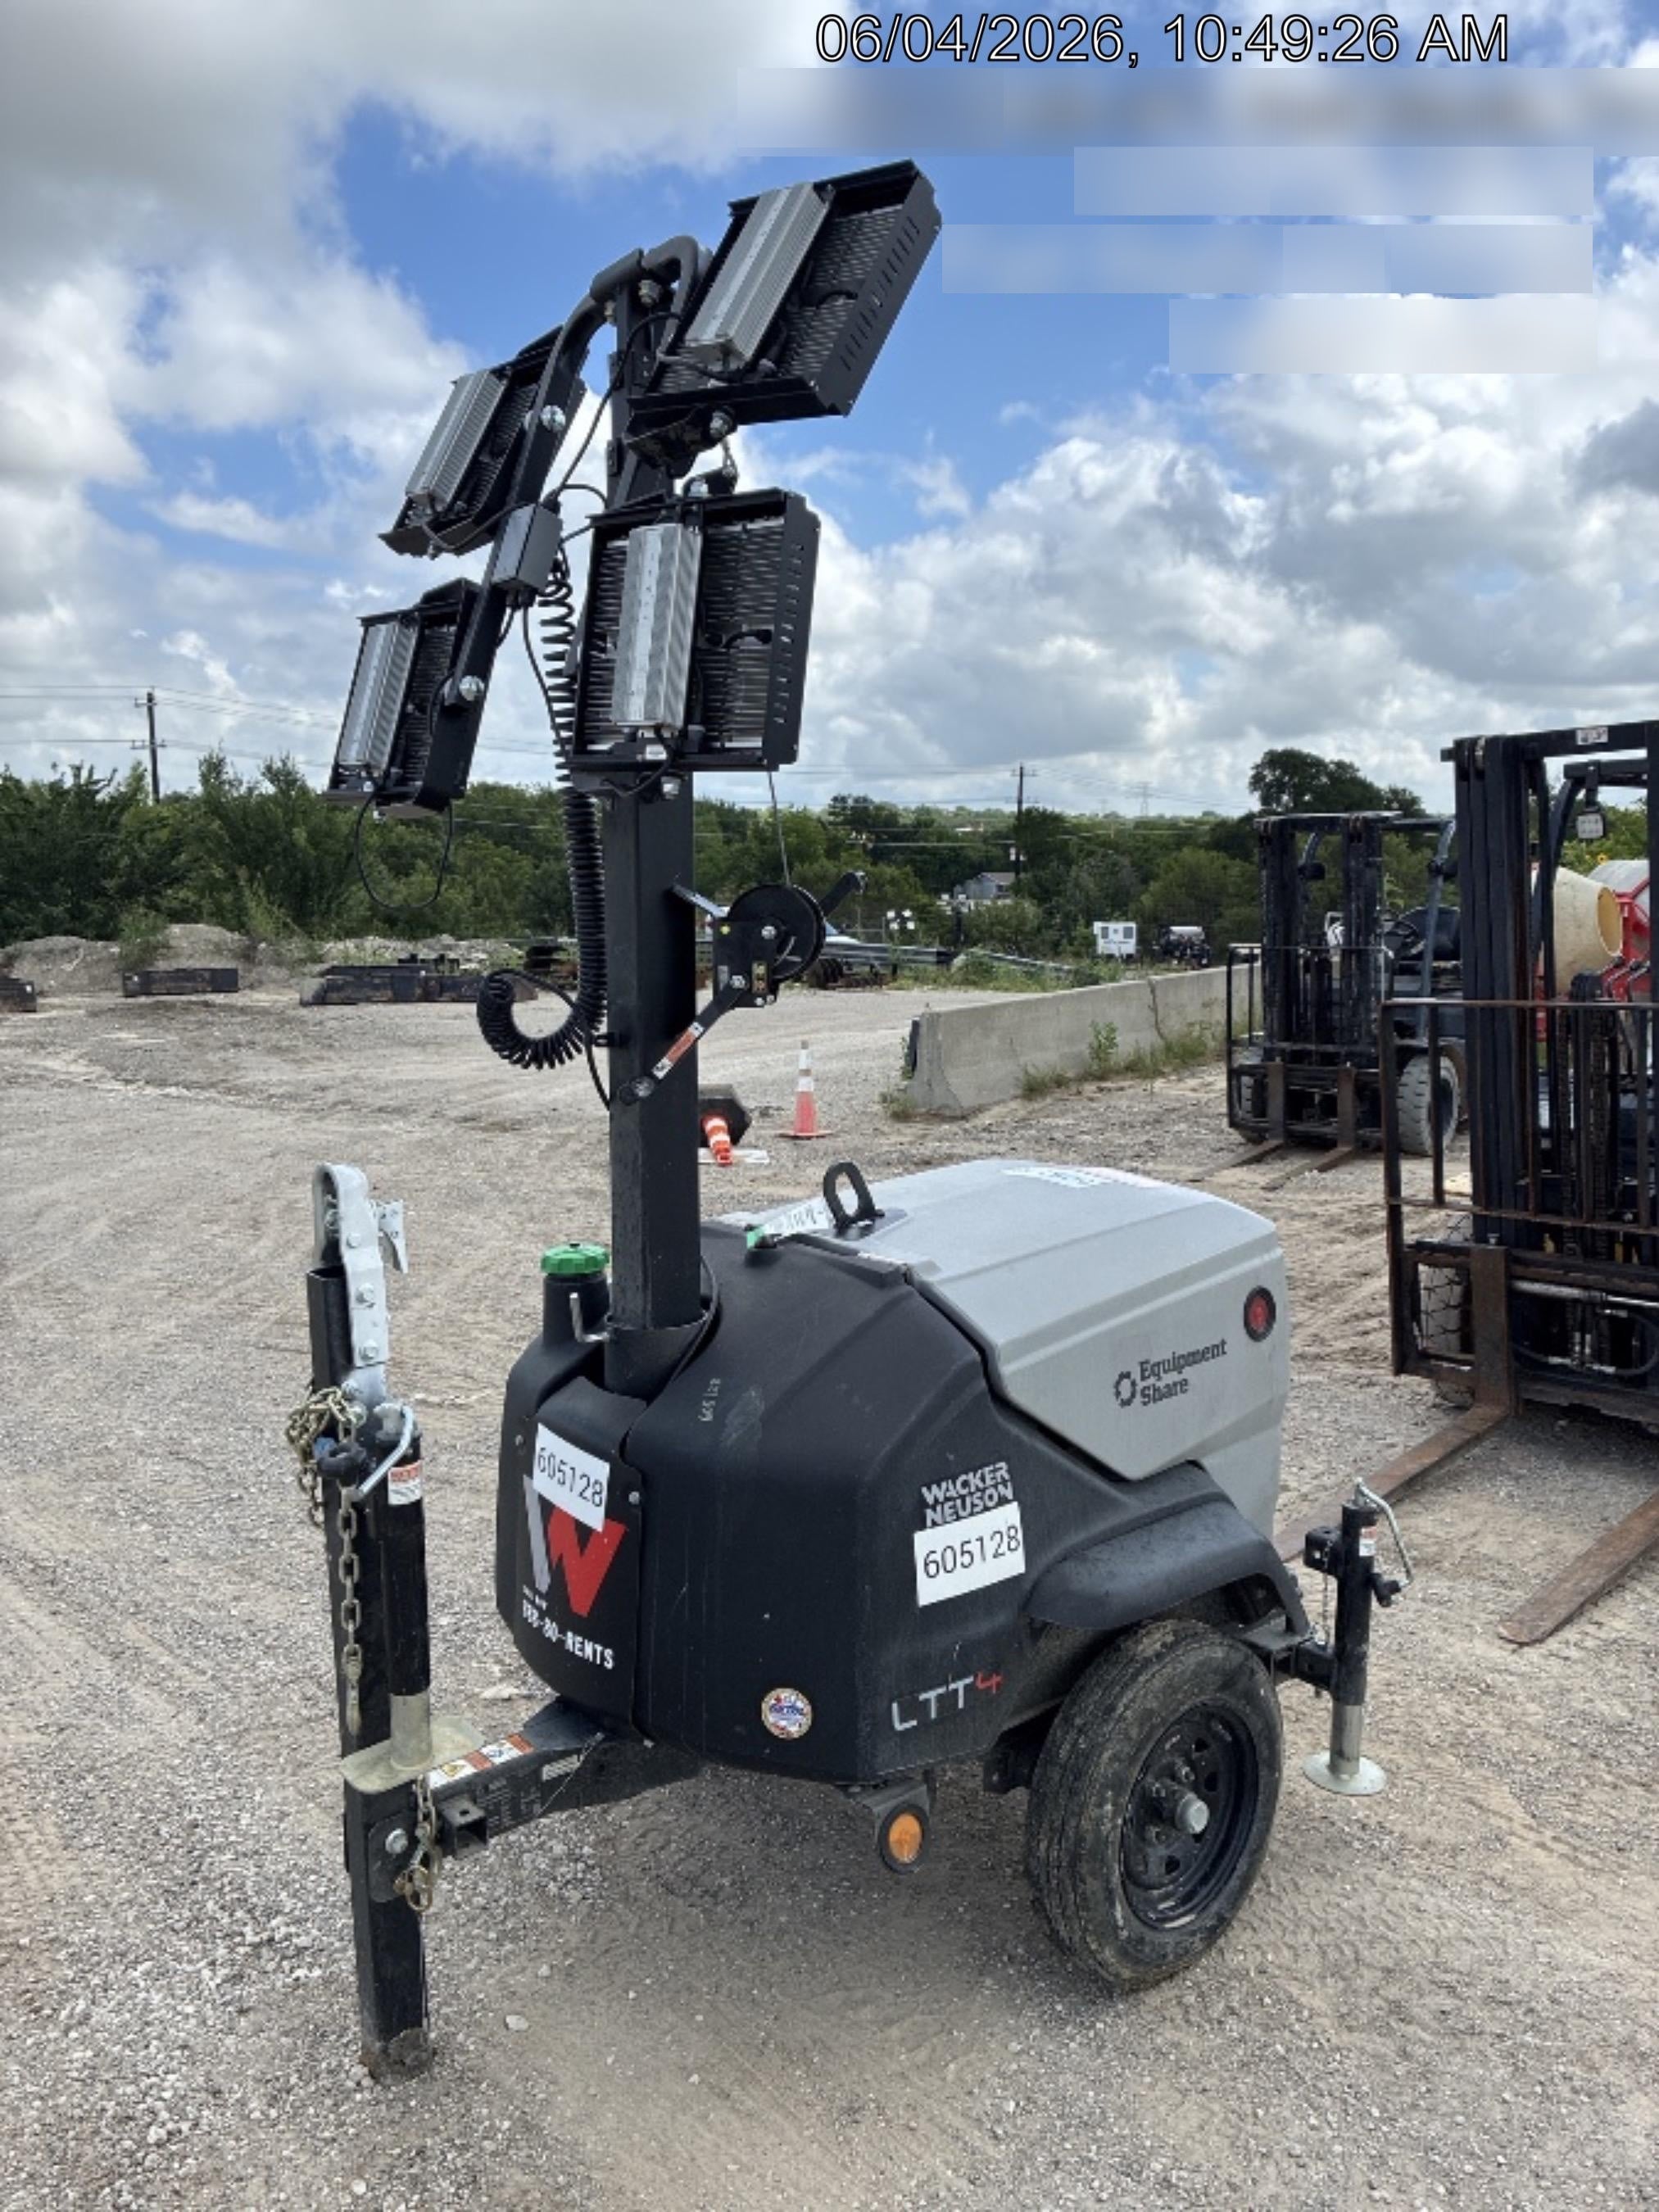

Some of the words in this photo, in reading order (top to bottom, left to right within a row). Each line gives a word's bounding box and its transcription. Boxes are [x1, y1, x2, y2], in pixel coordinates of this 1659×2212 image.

[1139, 1338, 1227, 1382] Equipment
[1140, 1377, 1189, 1407] Share
[537, 1447, 604, 1507] 605128
[921, 1462, 1011, 1505] WACKER
[925, 1481, 1013, 1528] NEUSON
[922, 1525, 1022, 1579] 605128
